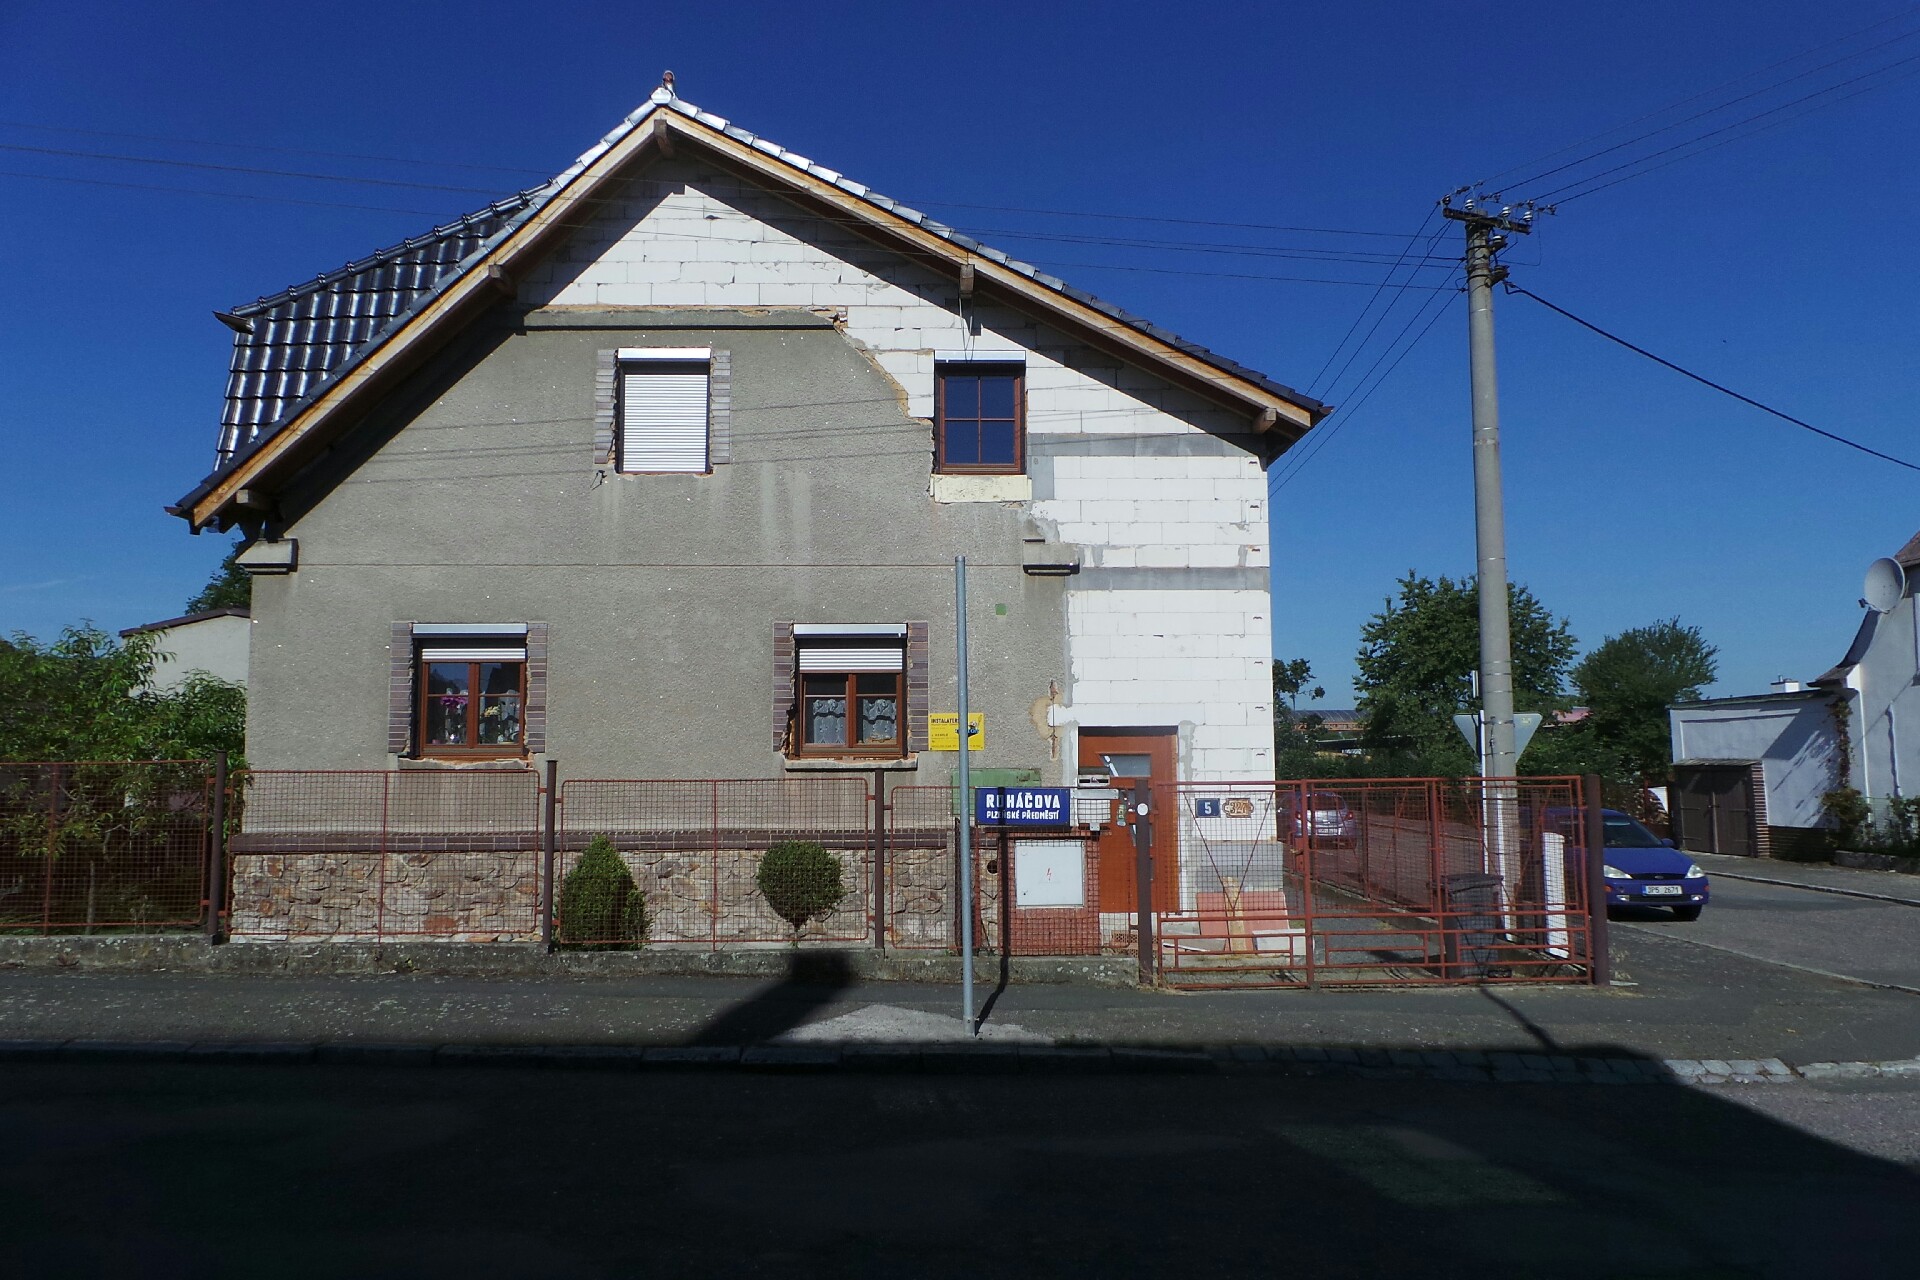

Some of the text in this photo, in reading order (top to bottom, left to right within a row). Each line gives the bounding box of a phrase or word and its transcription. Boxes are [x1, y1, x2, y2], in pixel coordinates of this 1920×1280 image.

[986, 791, 1061, 809] ROHÁČOVA
[1022, 810, 1060, 820] PŘEDMĚSTÍ
[1204, 801, 1212, 815] 5
